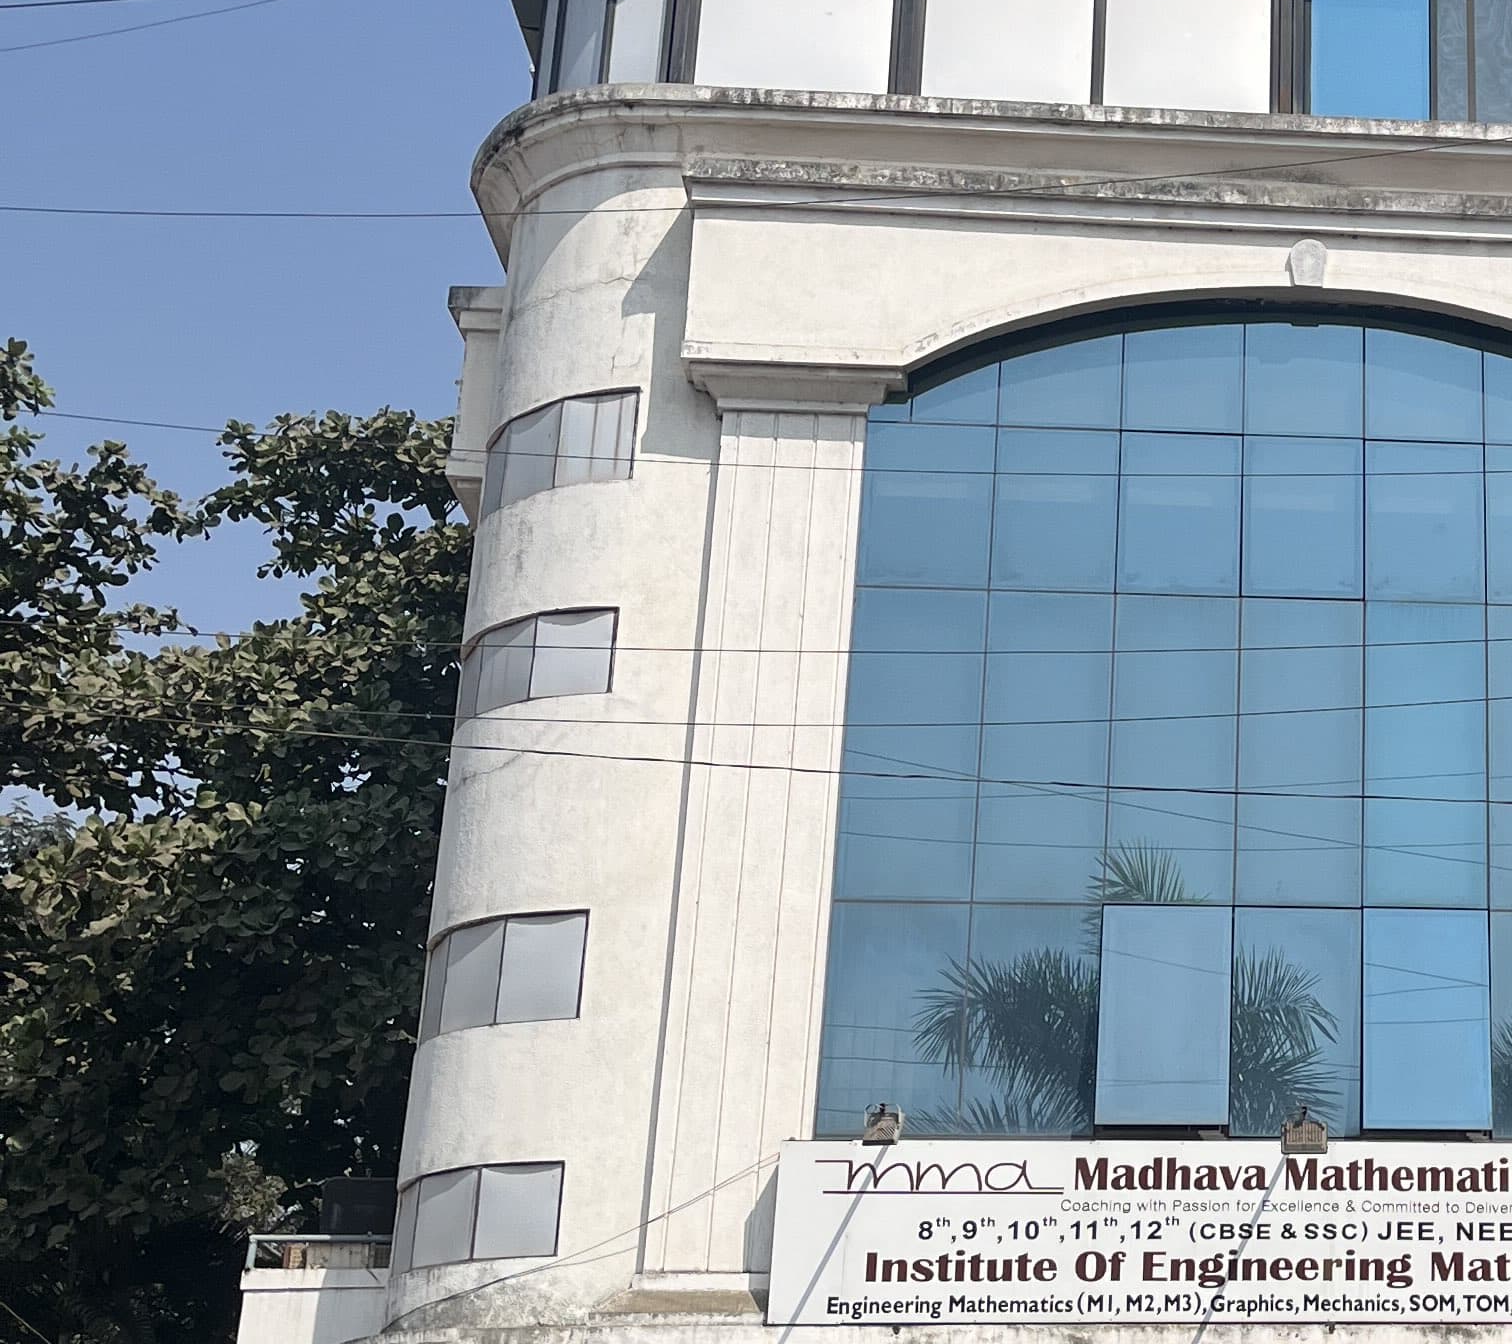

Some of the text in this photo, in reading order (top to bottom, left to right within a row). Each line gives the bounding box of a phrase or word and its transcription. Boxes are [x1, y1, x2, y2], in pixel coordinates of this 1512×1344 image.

[1074, 1156, 1269, 1192] Madhava
[1061, 1198, 1131, 1214] Coaching
[1137, 1199, 1166, 1212] with
[1172, 1199, 1231, 1212] Passion
[1236, 1199, 1258, 1212] for
[1262, 1199, 1339, 1212] Excellence
[1345, 1200, 1356, 1213] &
[1361, 1199, 1441, 1213] Committed
[1446, 1200, 1460, 1213] to
[1189, 1220, 1271, 1242] (CBSE
[1281, 1223, 1297, 1240] &
[1304, 1220, 1368, 1242] SSC)
[1378, 1221, 1444, 1244] JEE,
[864, 1249, 1057, 1283] Institute
[1075, 1250, 1125, 1282] Of
[1142, 1249, 1413, 1289] Engineering
[827, 1294, 942, 1320] Engineering
[948, 1294, 1073, 1314] Mathematics
[1210, 1294, 1300, 1318] Graphics,
[1303, 1294, 1405, 1314] Mechanics,
